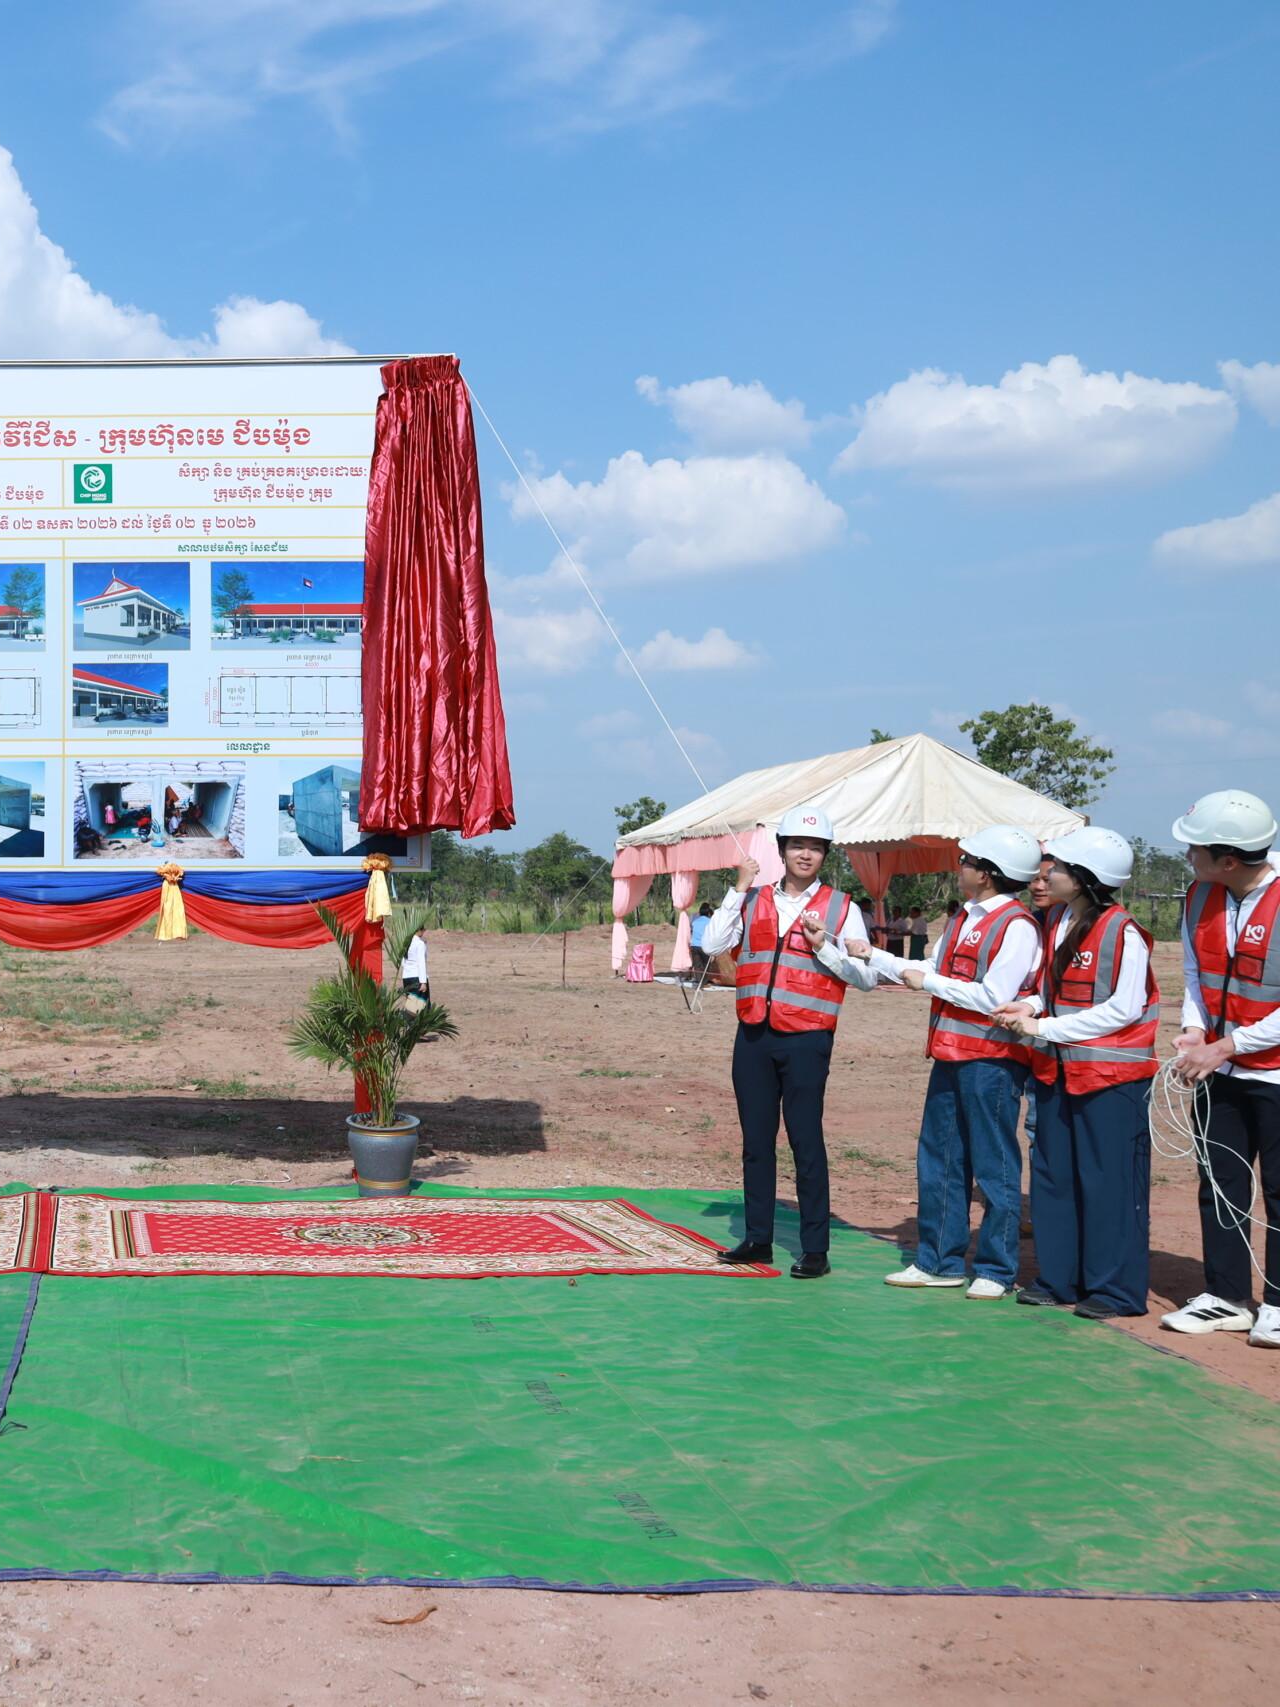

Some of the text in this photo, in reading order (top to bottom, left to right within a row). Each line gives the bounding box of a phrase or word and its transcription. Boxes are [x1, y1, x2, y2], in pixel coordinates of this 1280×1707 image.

[98, 423, 225, 454] ក្រុមហ៊ុនមេ
[232, 418, 311, 453] ជីបម៉ុង
[178, 462, 210, 481] សិក្សា
[213, 462, 233, 477] និង
[4, 484, 45, 504] ជីបម៉ុង
[213, 485, 262, 502] ក្រុមហ៊ុន
[265, 482, 305, 502] ជីបម៉ុង
[12, 516, 33, 529] ០២
[36, 519, 74, 529] ឧសភា
[76, 515, 118, 529] ២០២៦
[120, 513, 144, 528] ដល់
[146, 513, 172, 533] ថ្ងៃទី
[175, 515, 196, 528] ០២
[215, 515, 256, 528] ២០២៦
